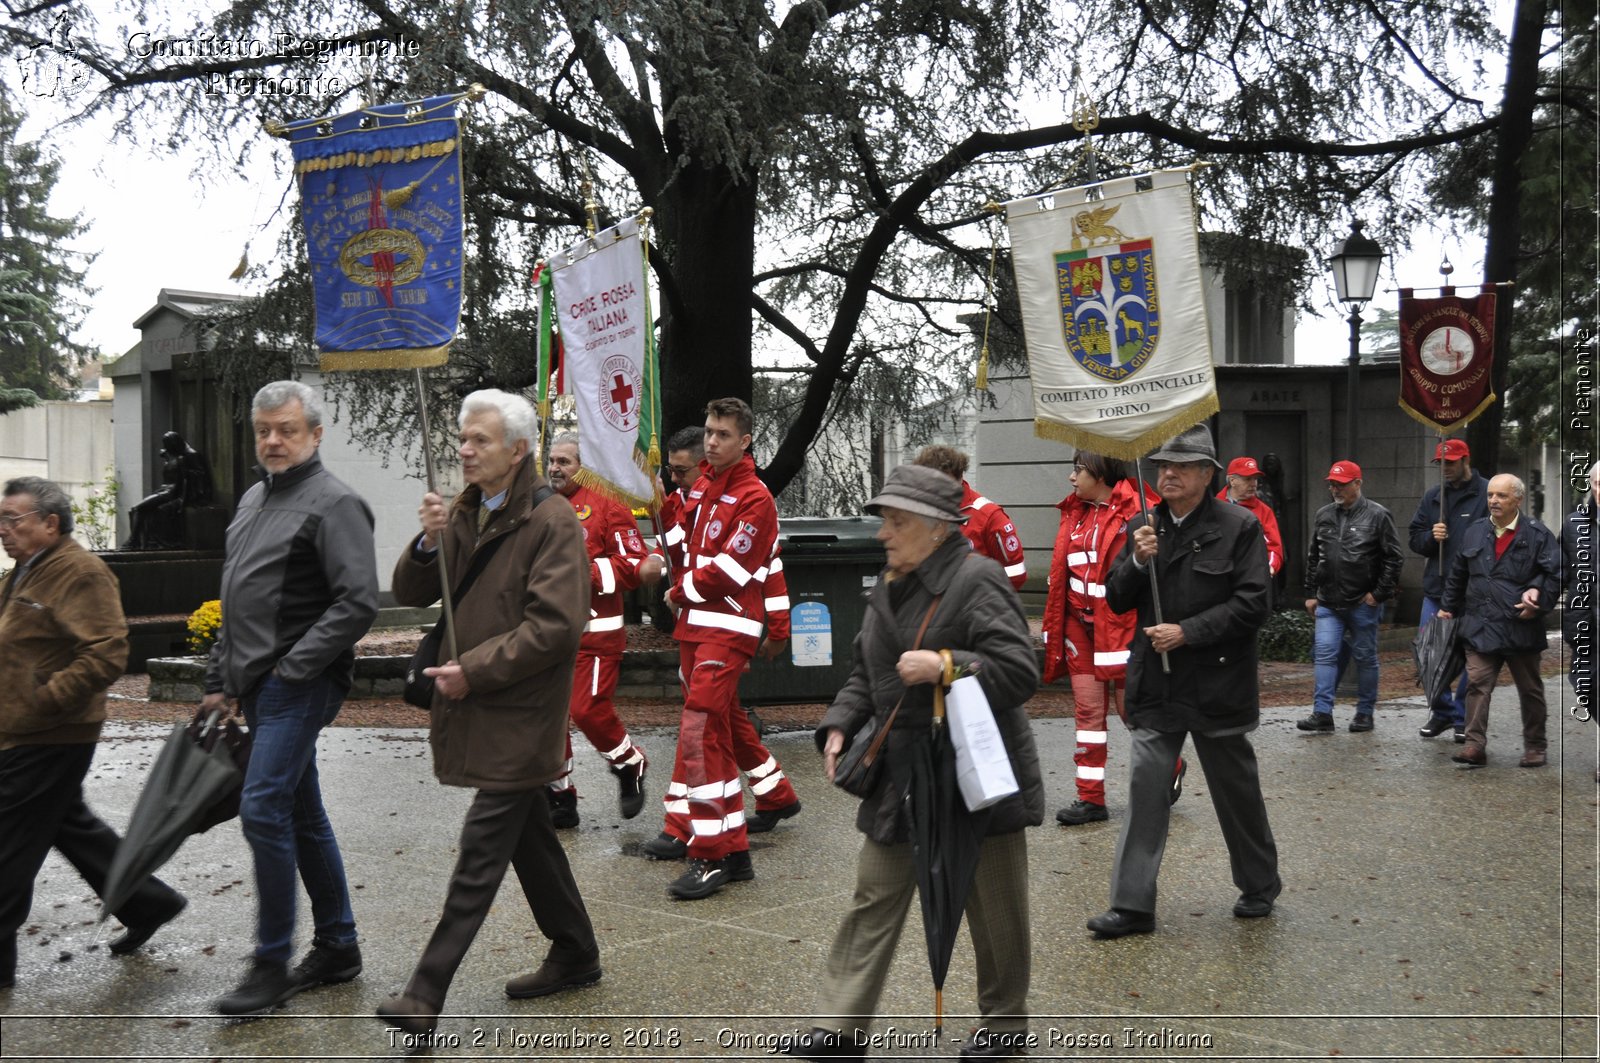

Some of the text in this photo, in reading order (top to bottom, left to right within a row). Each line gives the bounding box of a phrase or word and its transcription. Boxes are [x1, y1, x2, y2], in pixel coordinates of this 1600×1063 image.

[601, 281, 637, 307] ROSSA
[1142, 253, 1157, 312] DALMAZIA
[1130, 334, 1156, 368] GIULIA
[1081, 355, 1129, 378] VENEZIA
[1040, 372, 1208, 404] COMITATO PROVINCIALE
[1410, 367, 1486, 394] GRUPPO COMUNALE
[1250, 391, 1300, 403] ABATE
[1442, 397, 1450, 407] DI
[1097, 402, 1151, 419] TORINO
[1434, 409, 1461, 419] TORINO
